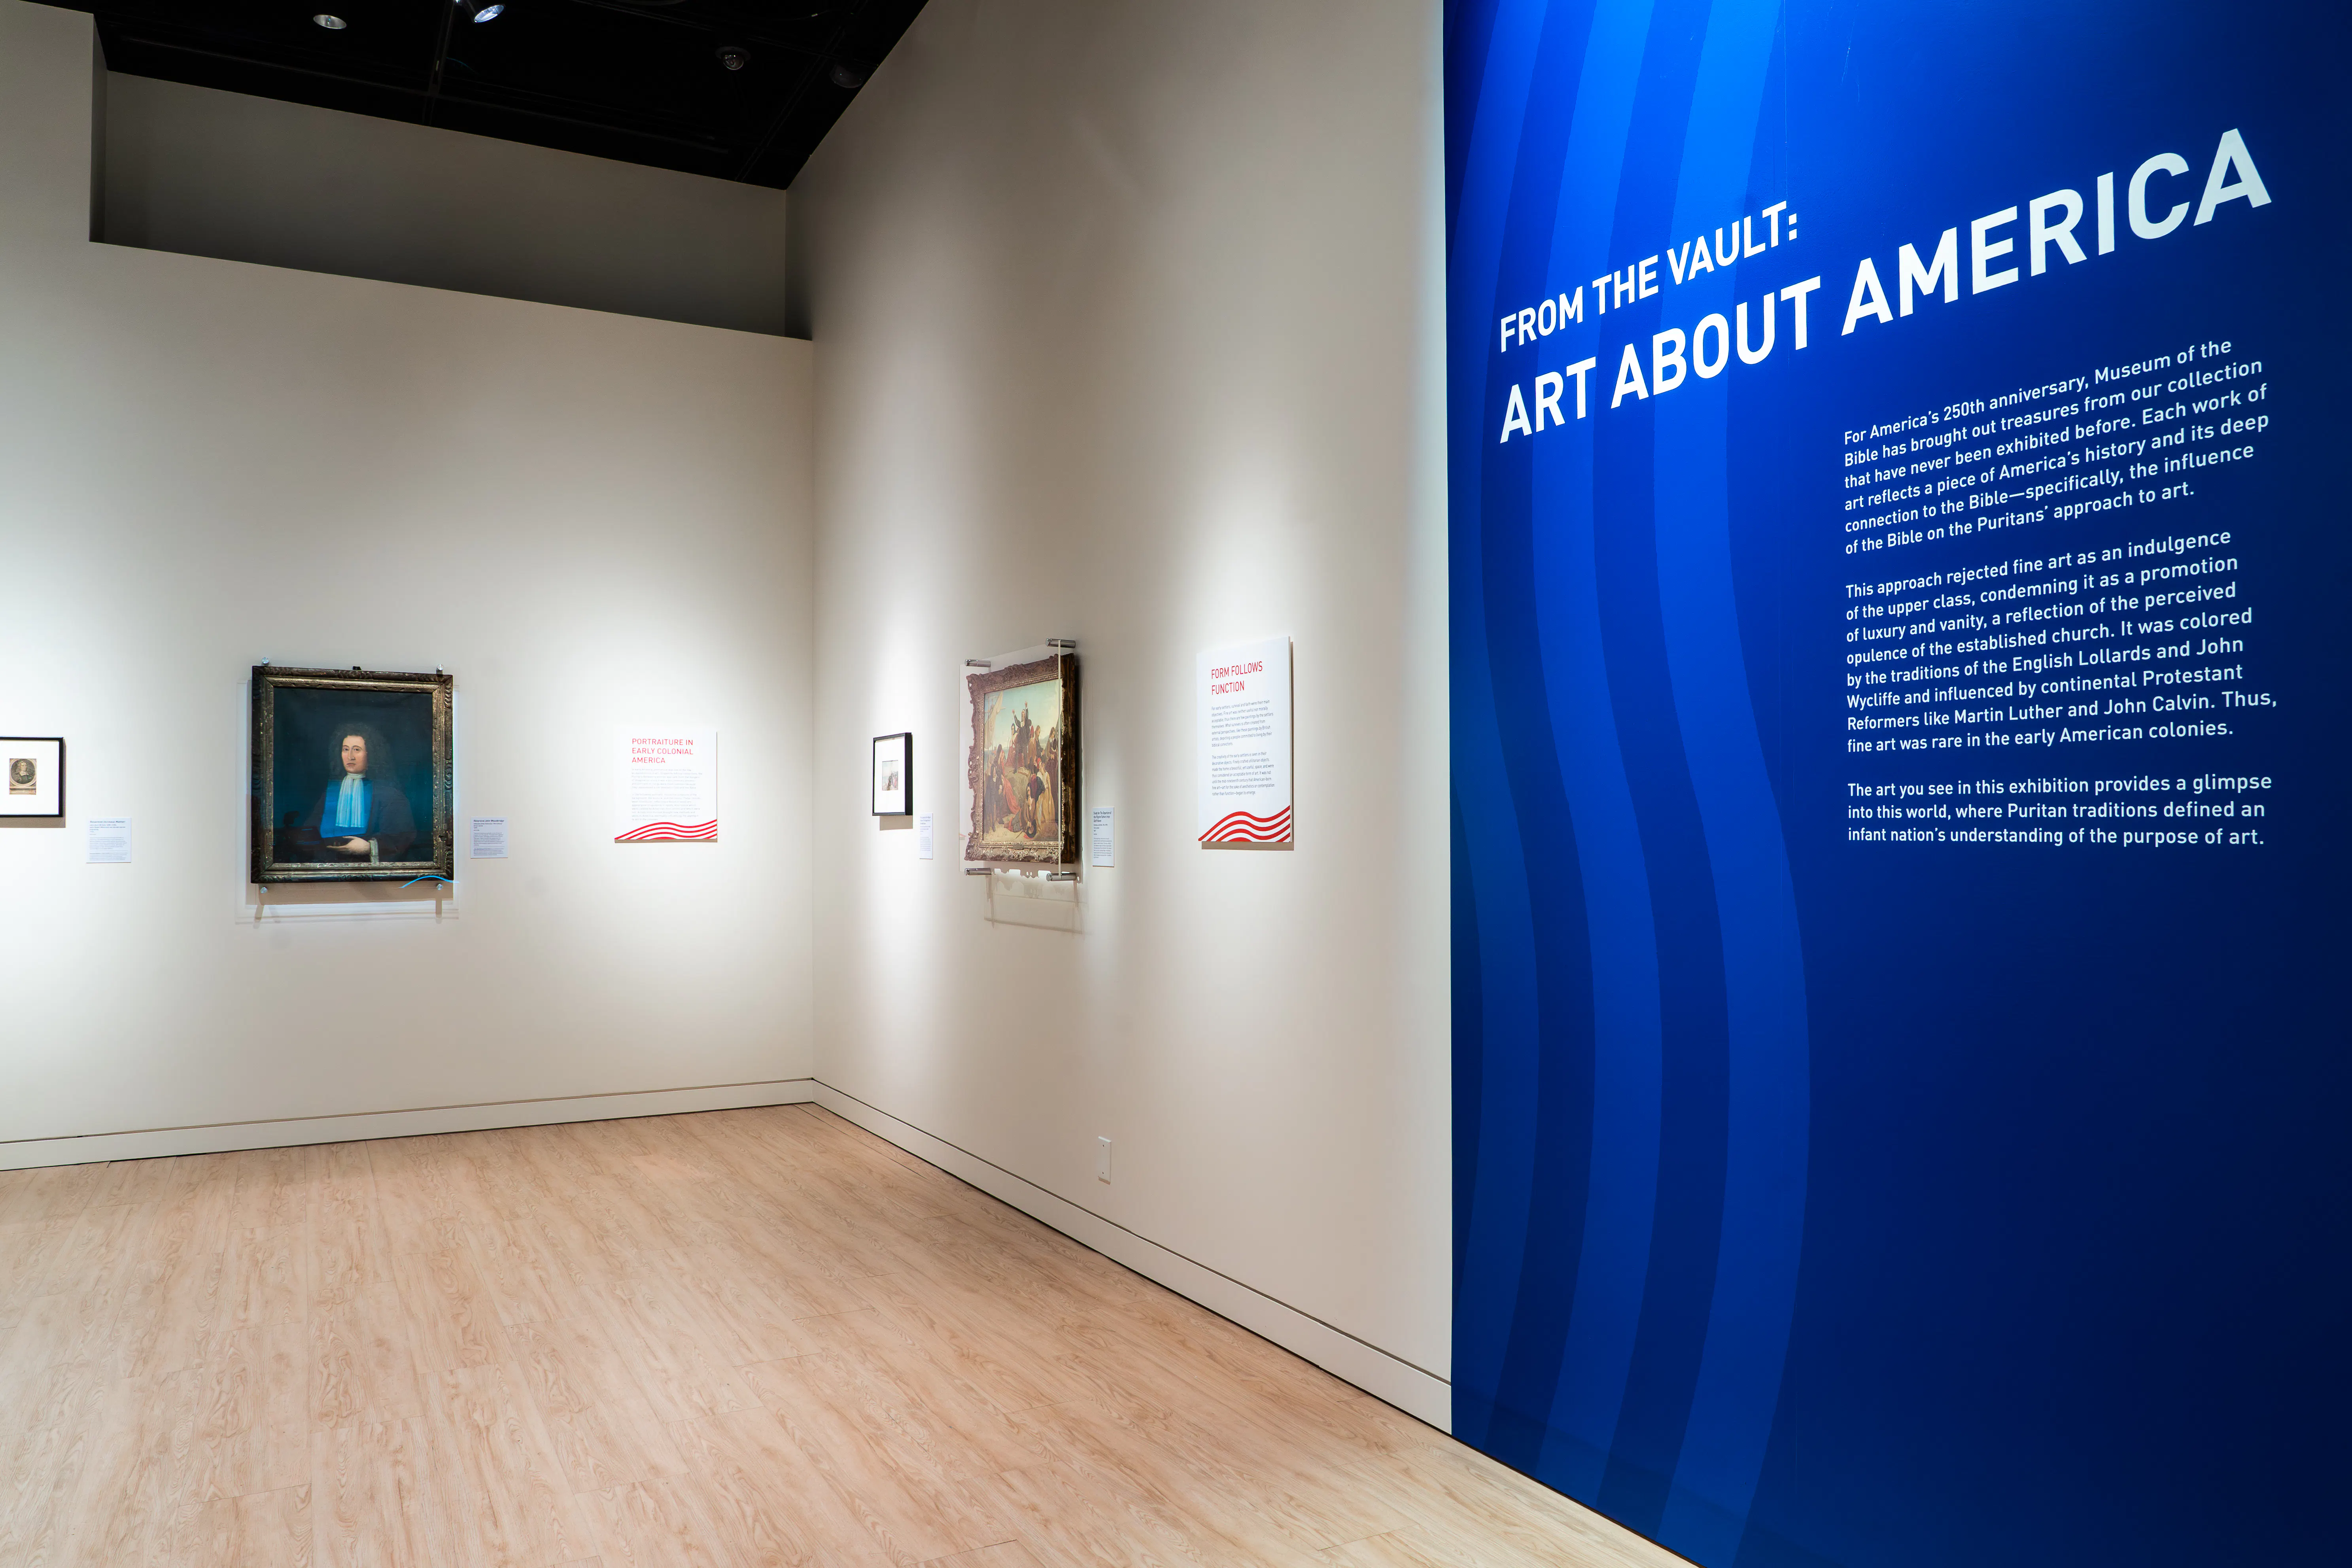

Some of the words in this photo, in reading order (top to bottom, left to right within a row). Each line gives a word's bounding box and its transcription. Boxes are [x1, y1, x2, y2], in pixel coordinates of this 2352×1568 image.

[1500, 357, 1596, 443] ART
[1611, 276, 1820, 409] ABOUT
[1842, 129, 2271, 336] AMERICA
[1501, 286, 1582, 352] FROM
[1592, 255, 1658, 315] THE
[1667, 200, 1797, 285] VAULT:
[1845, 431, 1866, 444] For
[1870, 411, 1939, 439] America’s
[1944, 399, 1984, 420] 250th
[1990, 376, 2088, 409] anniversary,
[2095, 356, 2170, 384] Museum
[2178, 346, 2195, 363] of
[2201, 341, 2231, 357] the
[1845, 449, 1878, 467] Bible
[1883, 444, 1906, 458] has
[1911, 427, 1967, 451] brought
[1972, 420, 1996, 437] out
[2001, 404, 2079, 430] treasures
[2084, 393, 2124, 411] from
[2132, 384, 2162, 400] our
[2168, 361, 2261, 392] collection
[1845, 472, 1870, 488] that
[1875, 467, 1906, 482] have
[1911, 457, 1951, 474] never
[1956, 448, 1991, 465] been
[1997, 427, 2069, 455] exhibited
[2076, 418, 2135, 439] before.
[2143, 403, 2186, 424] Each
[2192, 390, 2241, 413] work
[2248, 383, 2267, 401] of
[1845, 496, 1864, 510] art
[1868, 486, 1920, 506] reflects
[1925, 484, 1932, 494] a
[1938, 475, 1975, 496] piece
[1981, 467, 1995, 483] of
[1999, 452, 2079, 479] America’s
[2086, 440, 2146, 462] history
[2152, 428, 2184, 448] and
[2192, 426, 2214, 441] its
[2221, 416, 2268, 435] deep
[1845, 509, 1918, 532] connection
[1923, 505, 1936, 517] to
[1941, 500, 1964, 514] the
[1970, 469, 2123, 509] Bible—specifically,
[2130, 463, 2157, 479] the
[2165, 446, 2253, 473] influence
[1846, 540, 1858, 554] of
[1862, 538, 1883, 551] the
[1888, 530, 1922, 547] Bible
[1928, 528, 1944, 540] on
[1949, 522, 1972, 536] the
[1978, 506, 2048, 531] Puritans’
[2054, 492, 2132, 520] approach
[2139, 490, 2155, 503] to
[2162, 482, 2193, 499] art.
[1212, 667, 1229, 679] FORM
[1232, 661, 1262, 675] FOLLOWS
[1212, 681, 1244, 694] FUNCTION
[1848, 783, 1872, 796] The
[1876, 783, 1895, 796] art
[1900, 785, 1923, 799] you
[1928, 785, 1953, 794] see
[1959, 781, 1970, 794] in
[1976, 779, 2004, 794] this
[2010, 778, 2088, 793] exhibition
[2095, 775, 2170, 795] provides
[2177, 779, 2186, 790] a
[2193, 774, 2271, 794] glimpse
[1849, 806, 1872, 818] into
[1877, 805, 1902, 818] this
[1906, 804, 1950, 820] world,
[1956, 804, 2002, 817] where
[2008, 803, 2067, 817] Puritan
[2073, 802, 2157, 817] traditions
[2164, 801, 2233, 817] defined
[2242, 805, 2264, 816] an
[1849, 828, 1886, 840] infant
[1891, 828, 1945, 841] nation’s
[1951, 828, 2062, 846] understanding
[2069, 828, 2084, 842] of
[2090, 828, 2117, 843] the
[2124, 832, 2198, 847] purpose
[2205, 828, 2222, 844] of
[2229, 830, 2263, 844] art.
